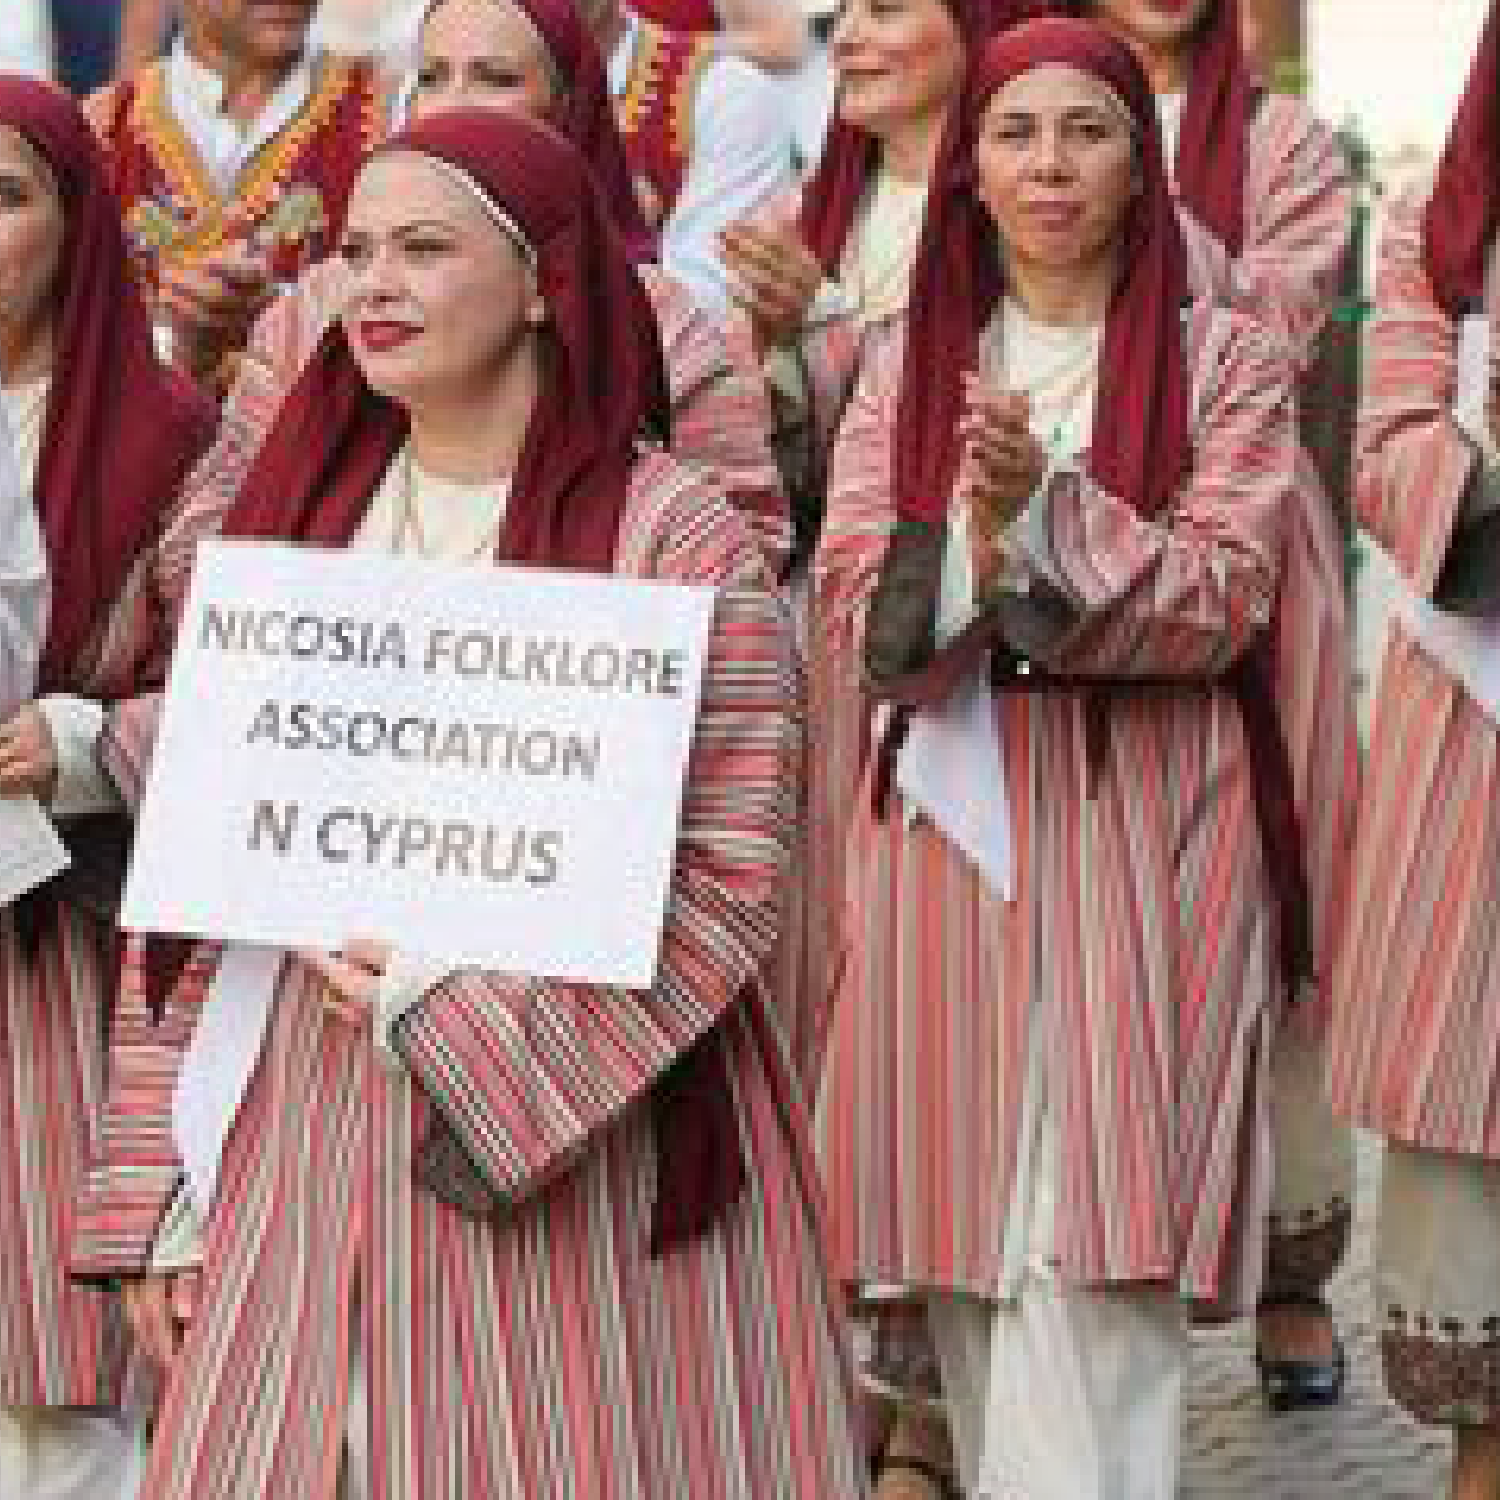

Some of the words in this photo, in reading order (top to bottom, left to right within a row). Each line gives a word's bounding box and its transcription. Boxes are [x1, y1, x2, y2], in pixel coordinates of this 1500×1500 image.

[201, 603, 404, 668] NICOSIA
[423, 629, 683, 695] FOLKLORE
[247, 700, 601, 779] ASSOCIATION
[248, 800, 298, 851] N
[316, 806, 565, 887] CYPRUS
